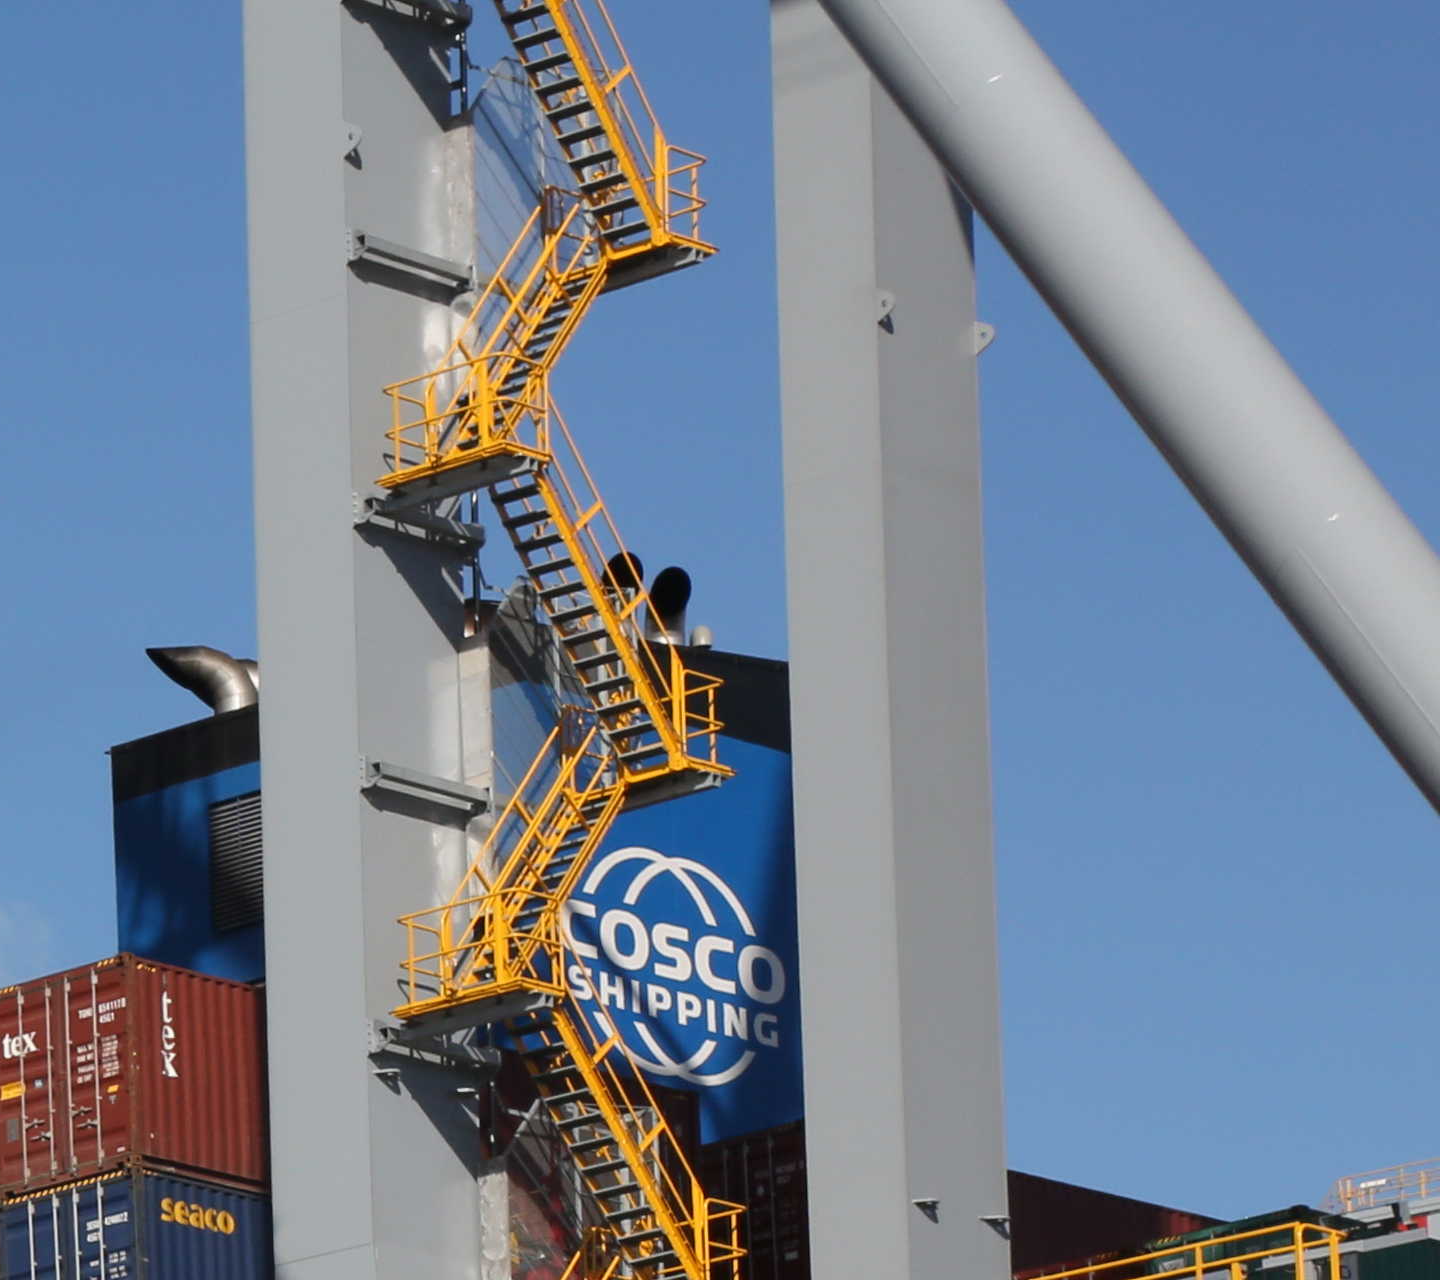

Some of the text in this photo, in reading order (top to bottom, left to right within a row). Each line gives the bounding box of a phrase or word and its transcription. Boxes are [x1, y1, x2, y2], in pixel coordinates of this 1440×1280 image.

[559, 898, 786, 1004] COSCO
[567, 964, 780, 1048] SHIPPING
[1, 1029, 38, 1059] tex
[161, 1195, 236, 1236] seaco
